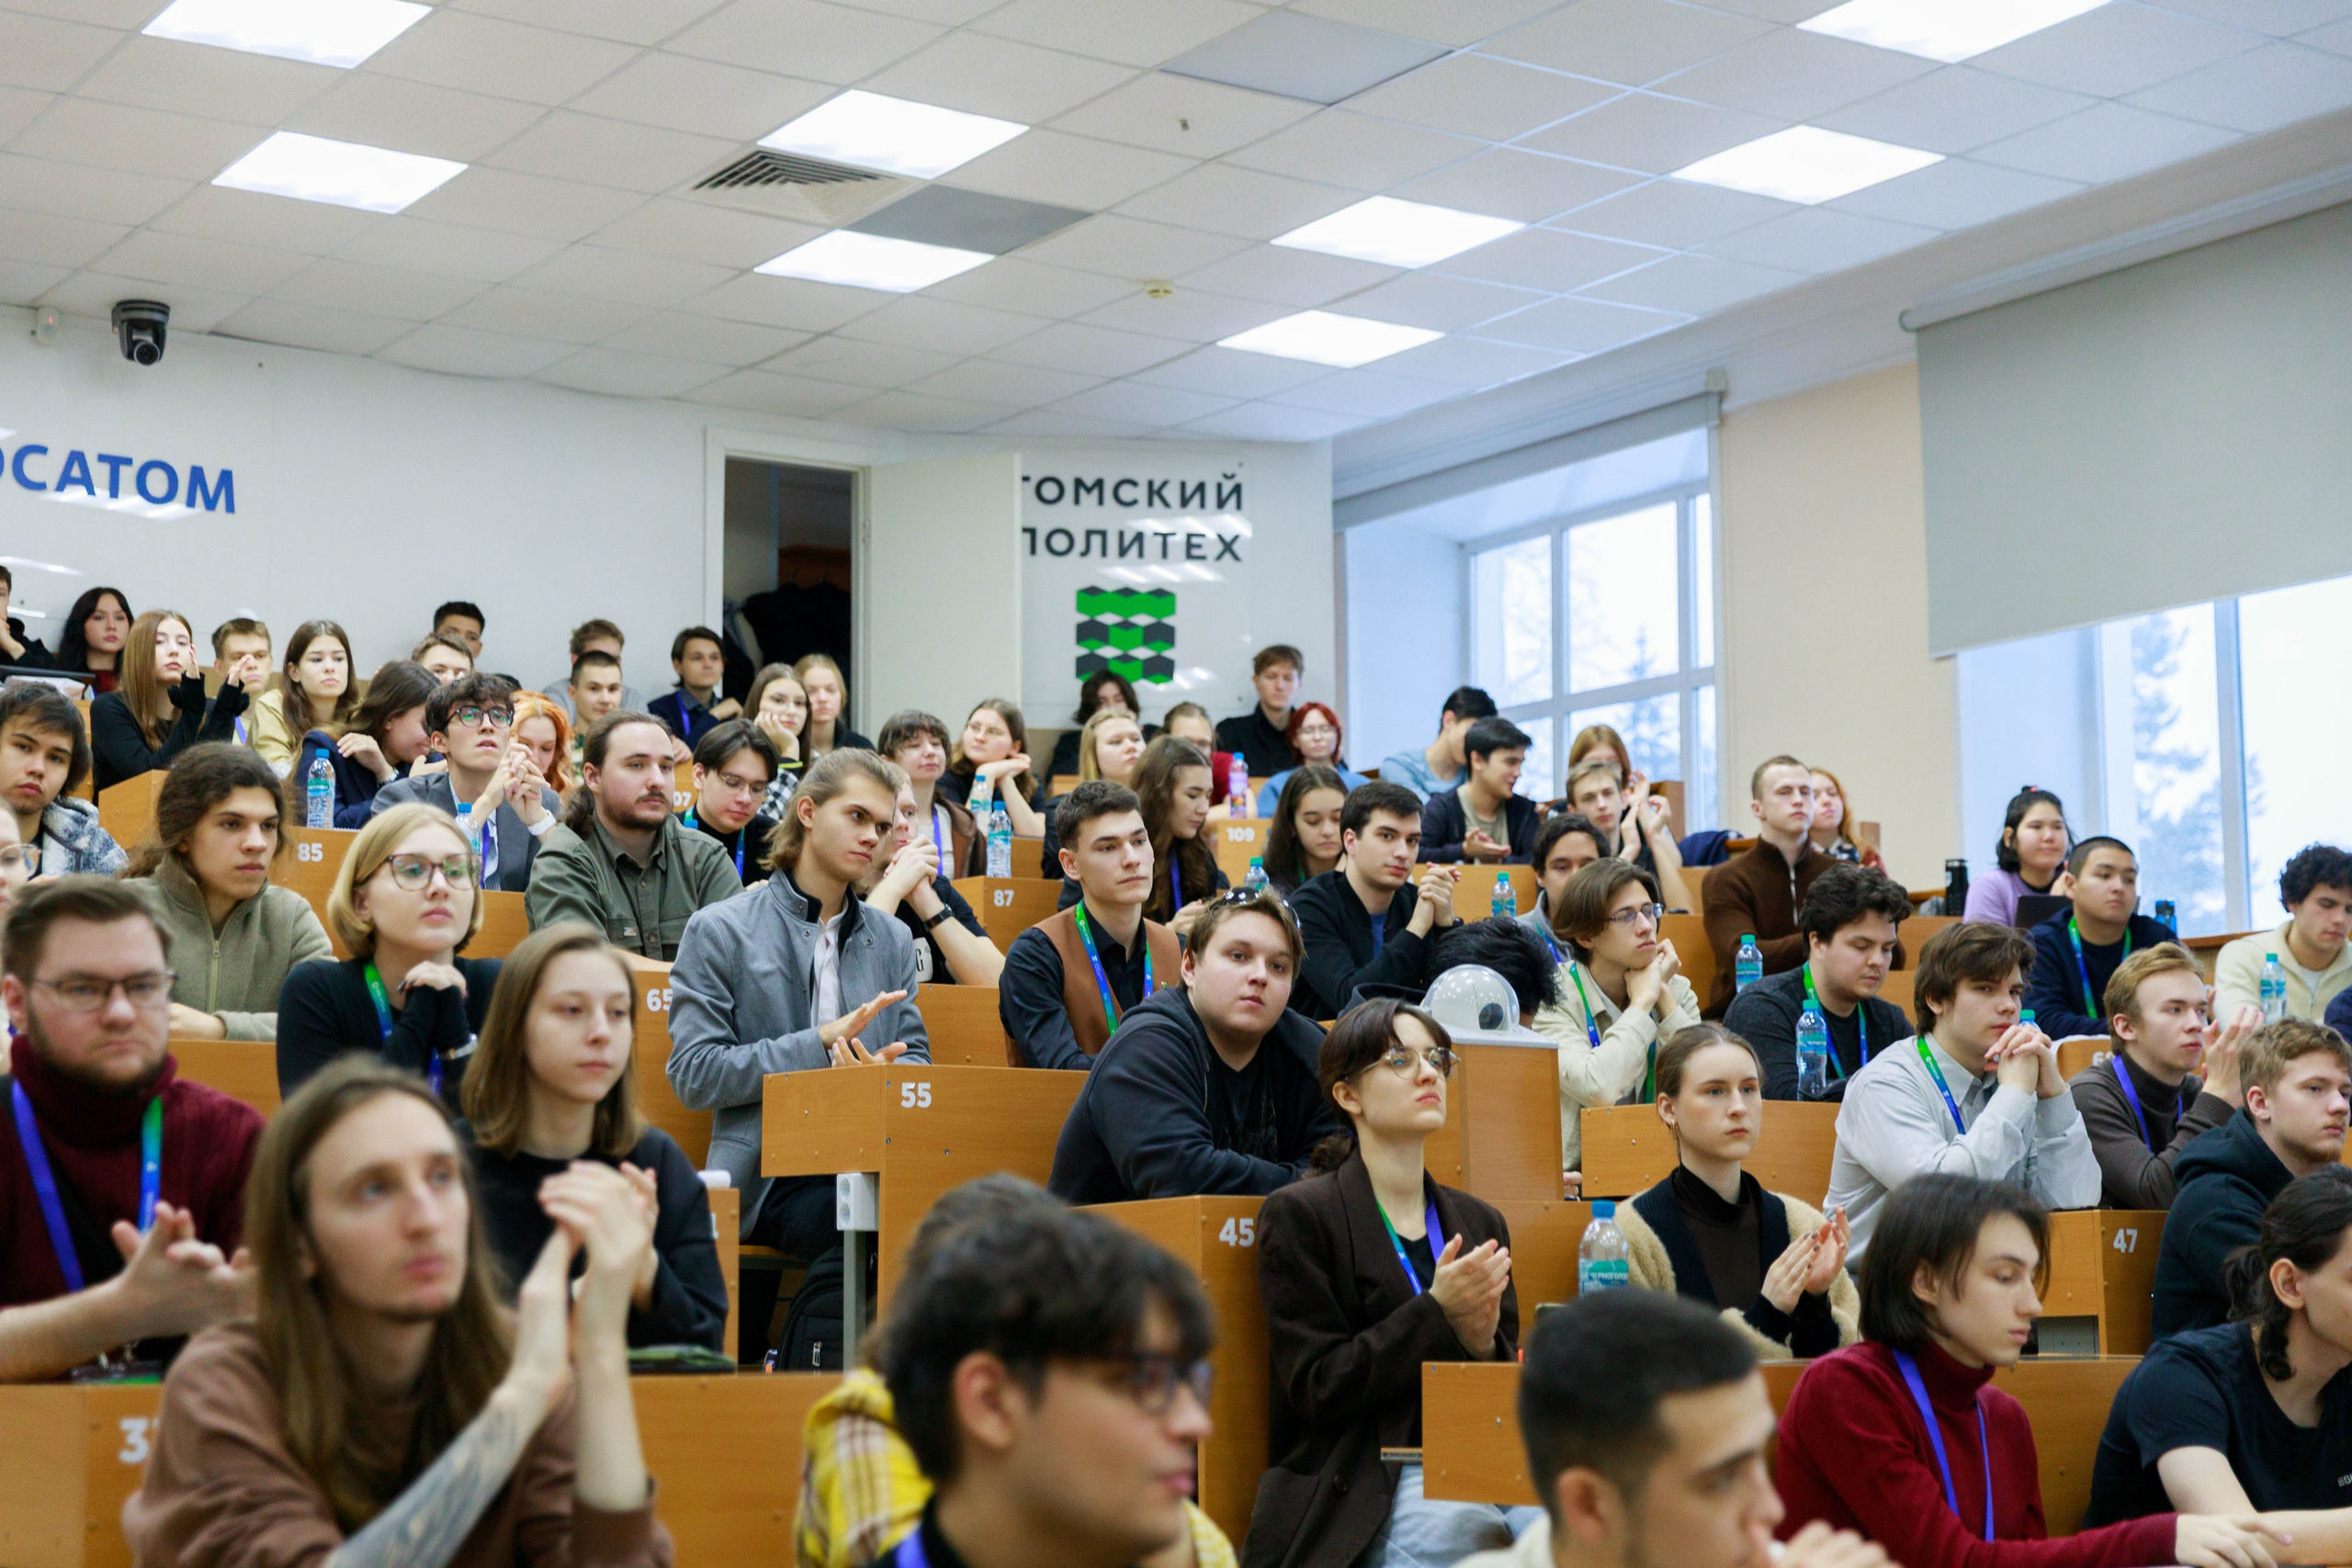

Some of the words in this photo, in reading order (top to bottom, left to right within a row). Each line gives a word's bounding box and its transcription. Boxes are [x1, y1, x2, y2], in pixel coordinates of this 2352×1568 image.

[0, 444, 235, 513] САТОМ
[1227, 827, 1255, 842] 109
[298, 842, 323, 863] 85
[993, 889, 1014, 907] 87
[646, 987, 673, 1012] 65
[900, 1081, 933, 1109] 55
[1218, 1217, 1255, 1247] 45
[2113, 1227, 2138, 1254] 47
[119, 1417, 160, 1464] 3
